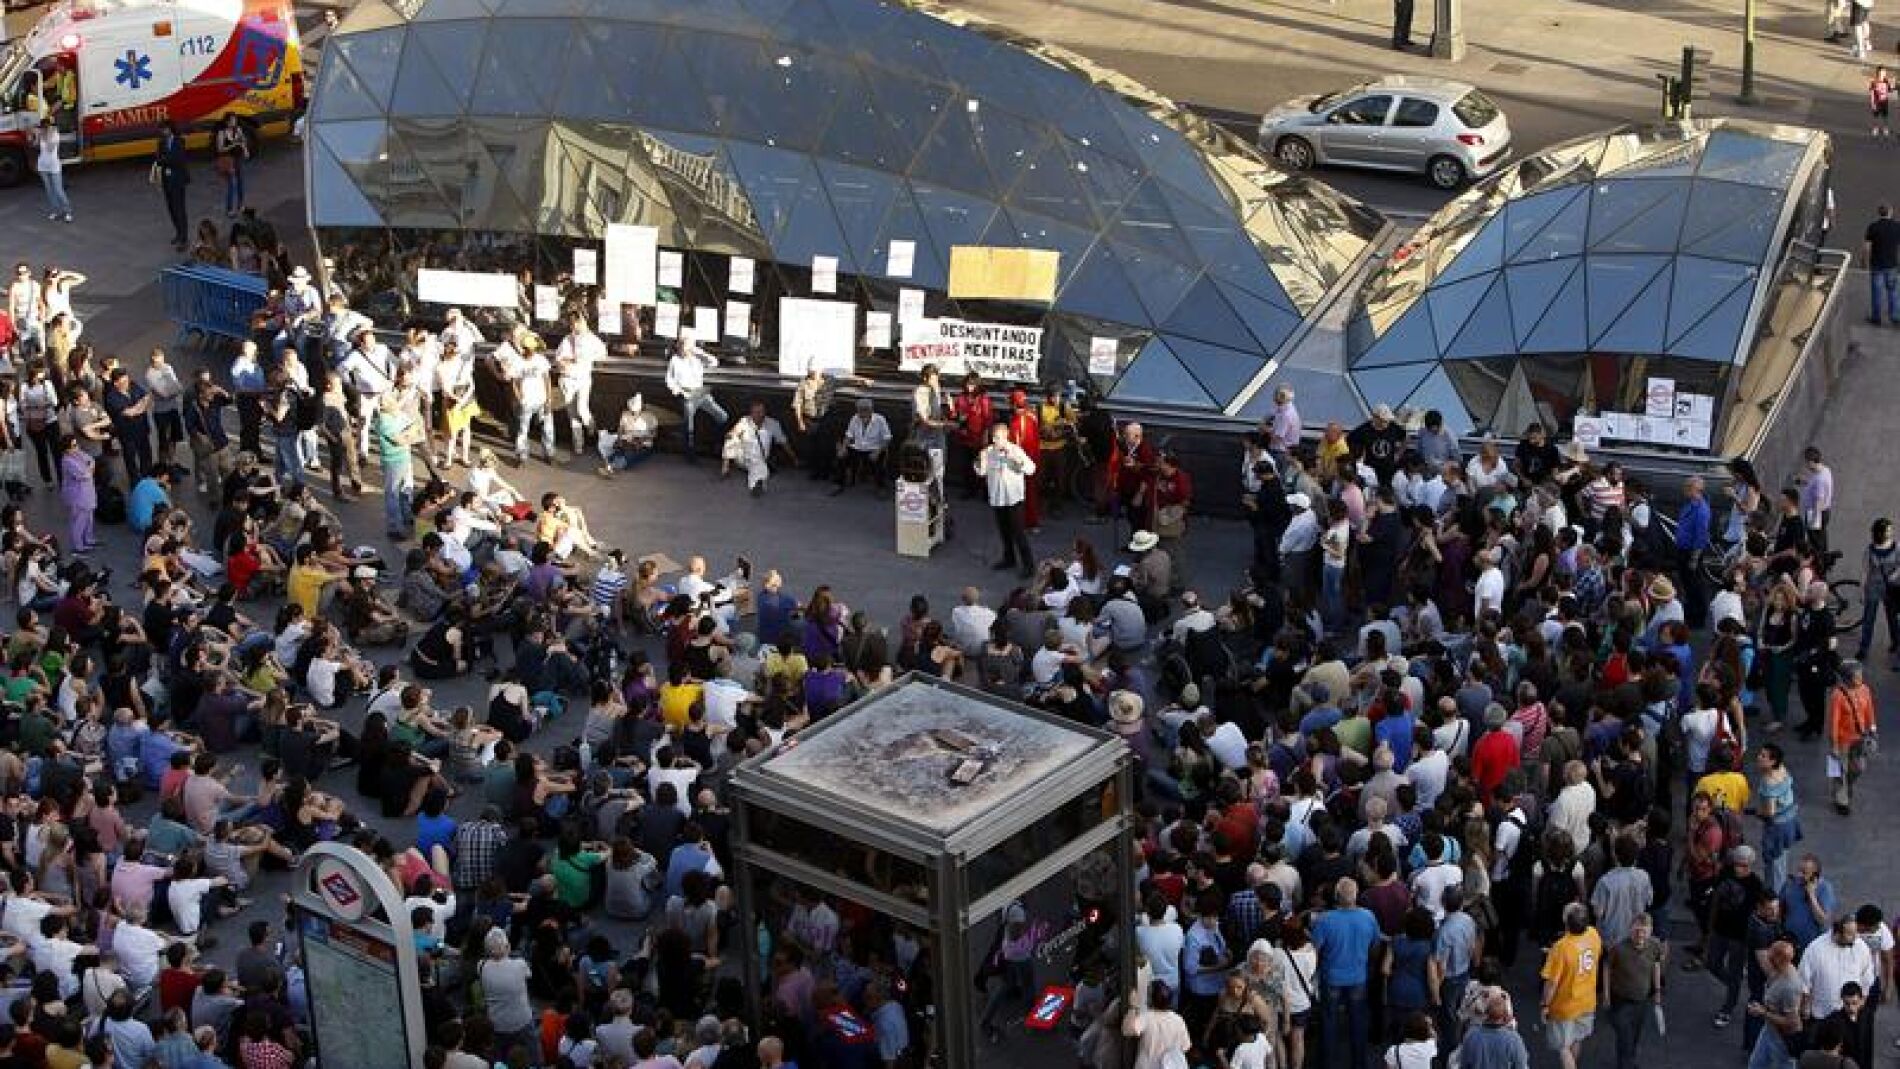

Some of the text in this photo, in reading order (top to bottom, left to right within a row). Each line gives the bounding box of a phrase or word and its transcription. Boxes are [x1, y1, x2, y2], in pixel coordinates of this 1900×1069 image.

[103, 106, 169, 127] SAMUR
[940, 322, 1036, 345] DESMONTANDO
[963, 342, 1034, 362] MENTIRAS
